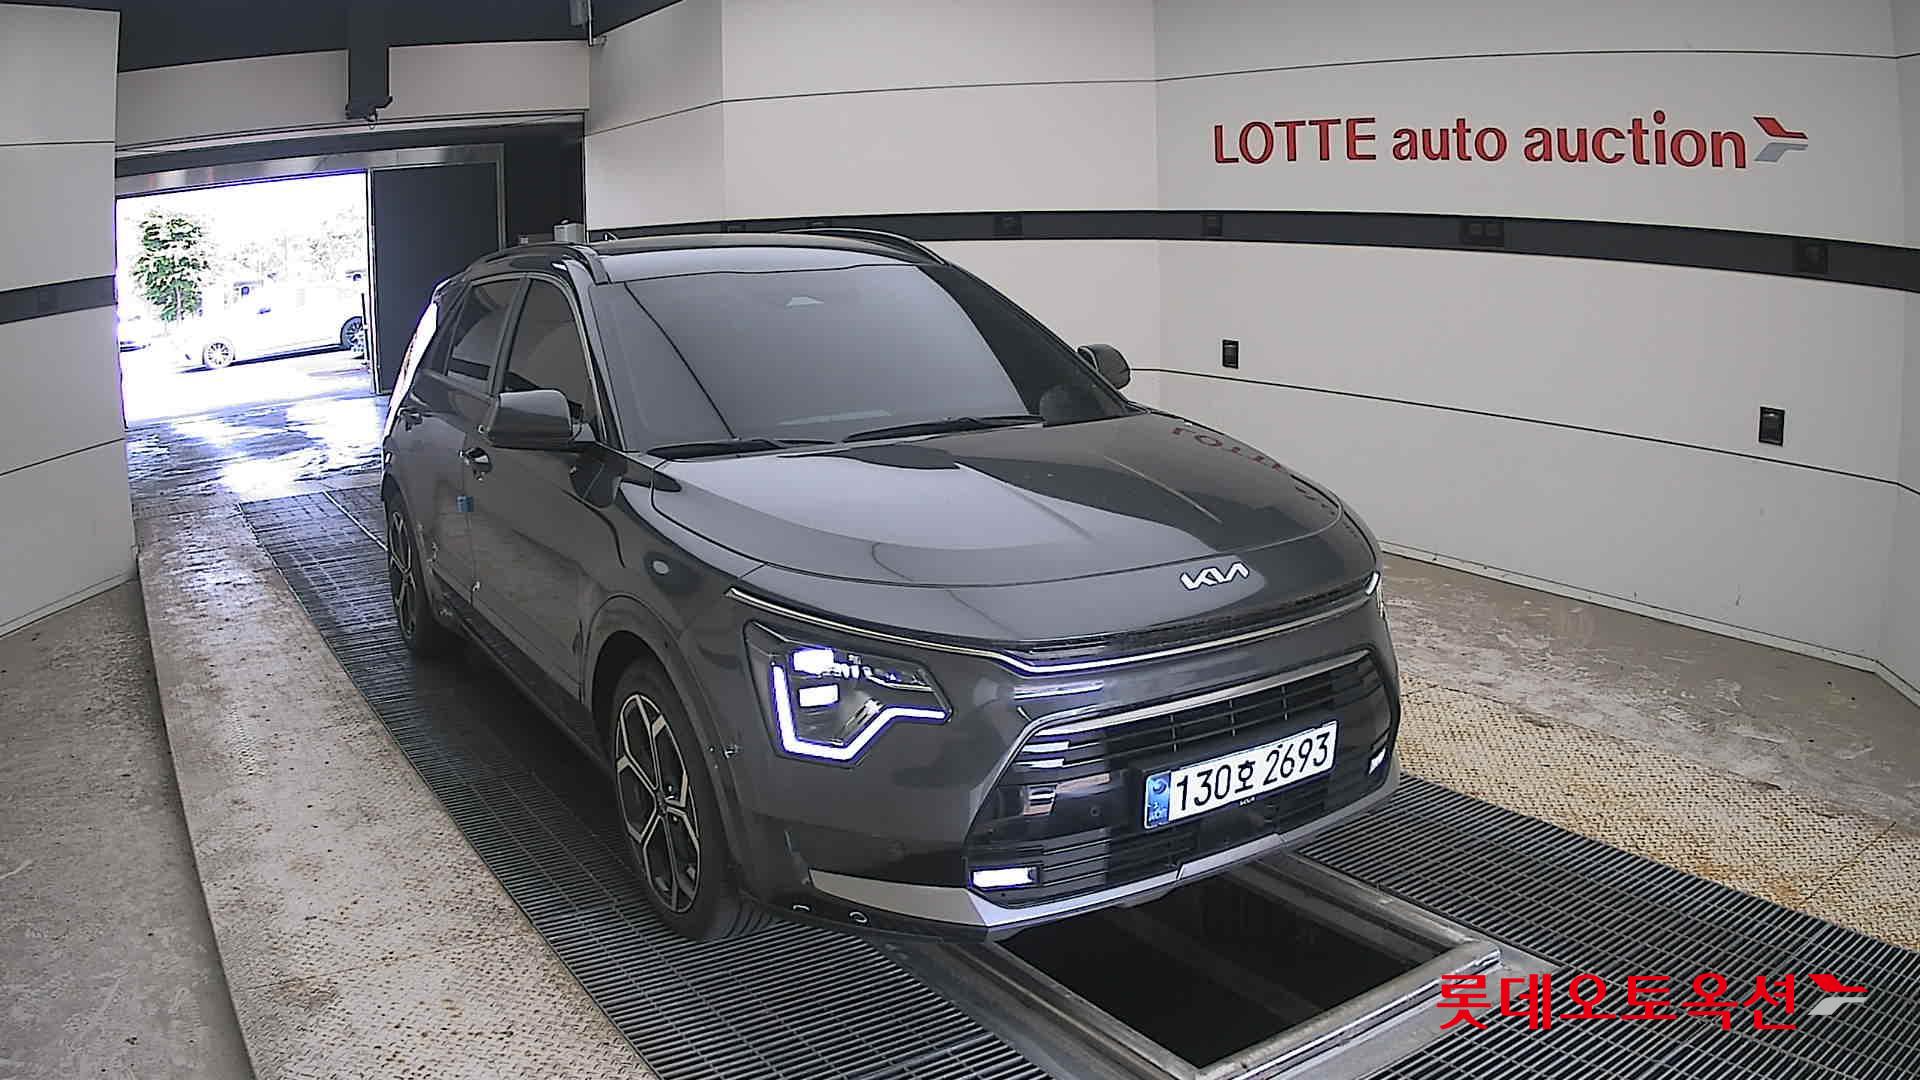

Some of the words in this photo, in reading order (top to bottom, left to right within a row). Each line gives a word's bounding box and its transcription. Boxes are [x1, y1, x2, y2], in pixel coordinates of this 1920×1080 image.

[1213, 117, 1377, 165] LOTTE
[1392, 118, 1508, 162] auto
[1523, 110, 1748, 169] auction
[1179, 561, 1250, 591] KIA
[1176, 760, 1256, 811] 130호
[1262, 731, 1330, 786] 2693
